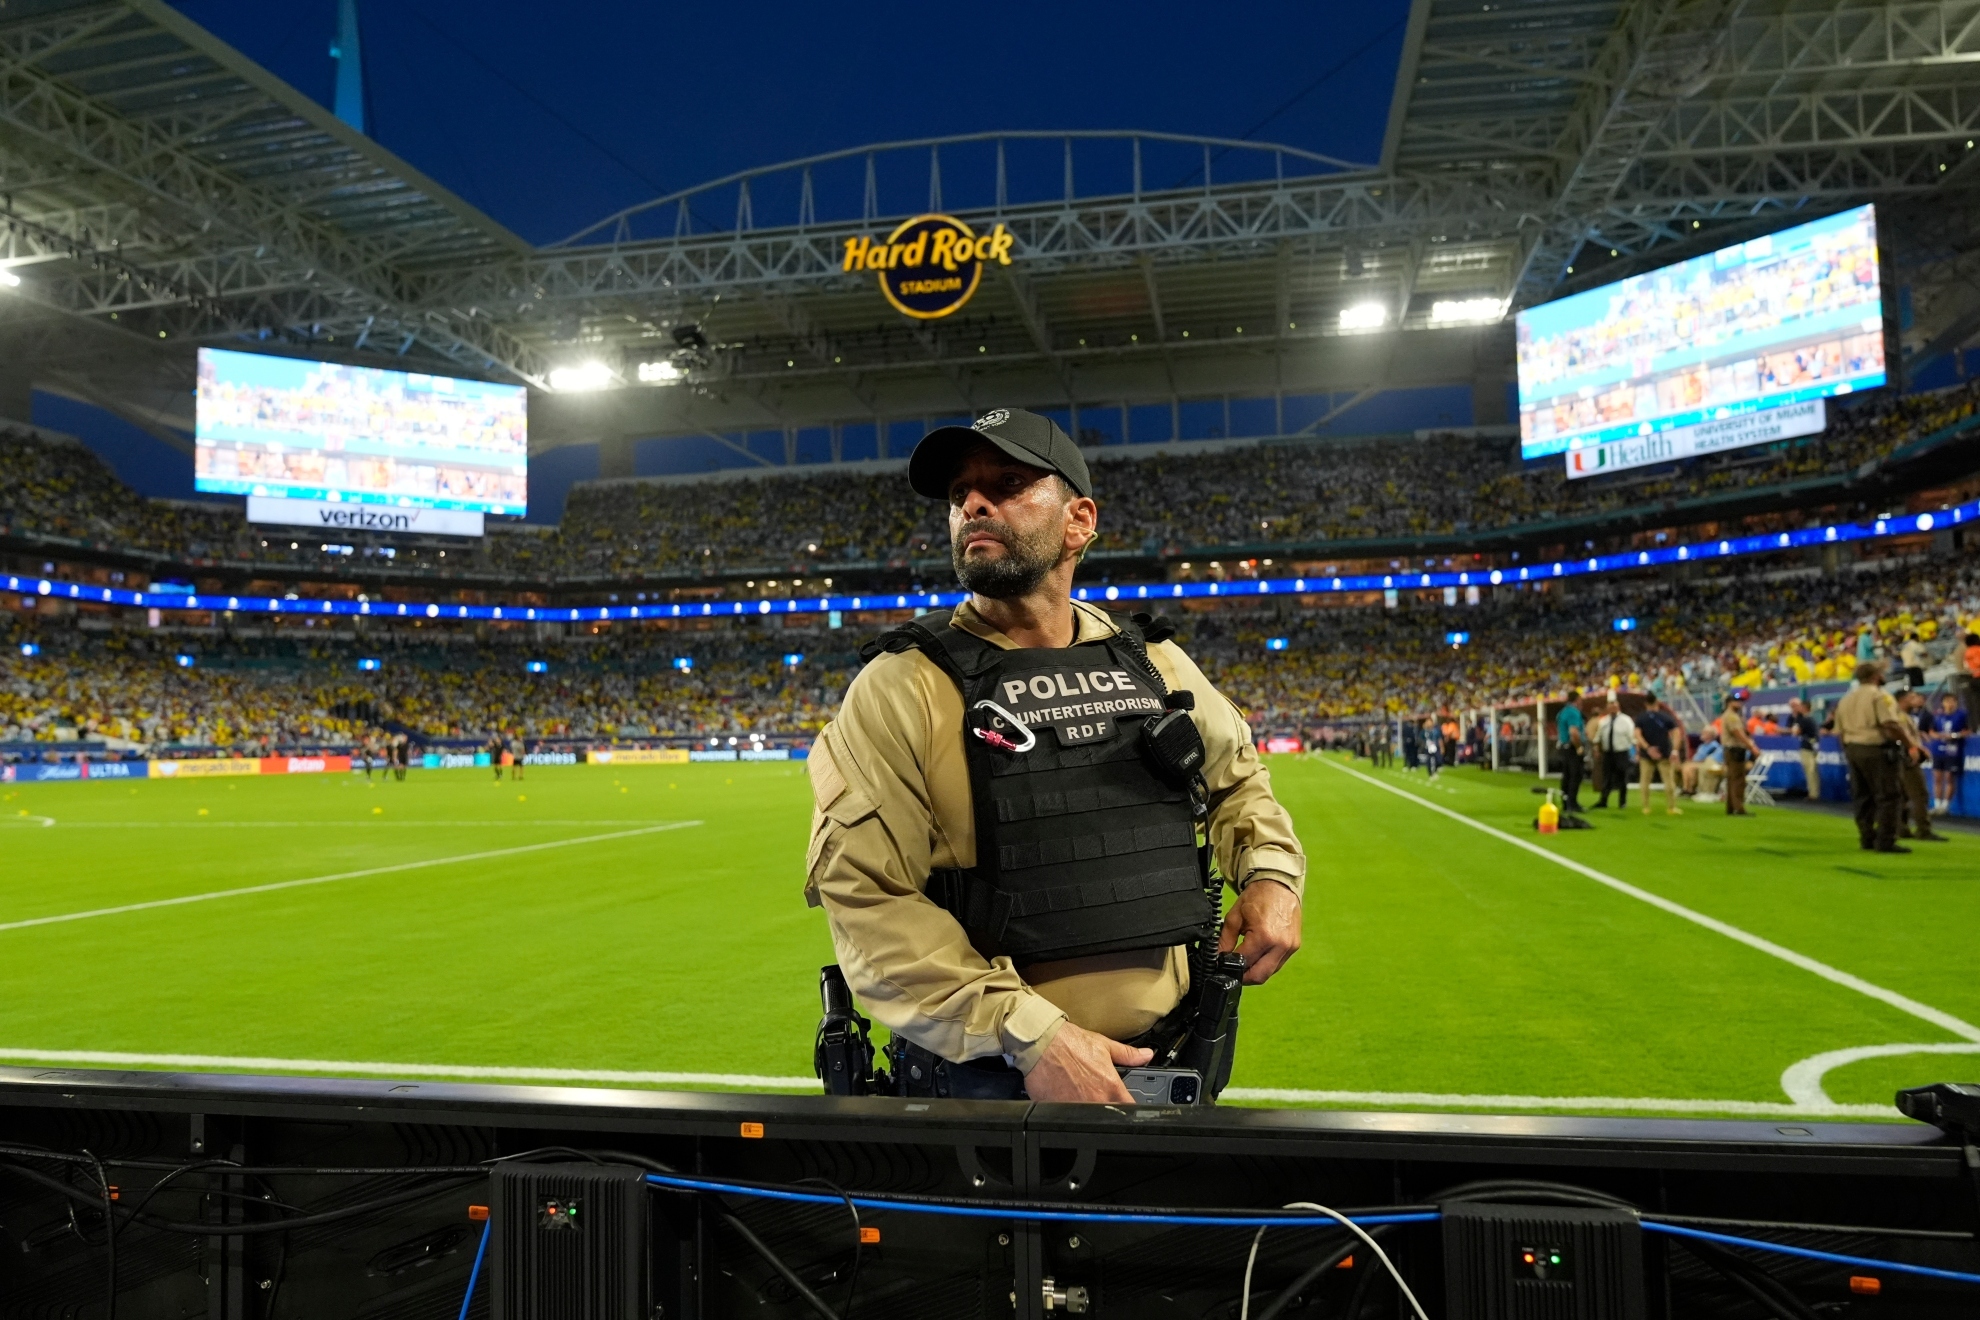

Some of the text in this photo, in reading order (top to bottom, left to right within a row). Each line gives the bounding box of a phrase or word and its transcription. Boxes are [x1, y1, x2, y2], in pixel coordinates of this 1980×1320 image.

[842, 222, 1014, 272] Hard Rock
[900, 277, 962, 295] STADIUM
[1693, 416, 1755, 437] UNIVERSITY
[1758, 413, 1772, 424] OF
[1776, 404, 1816, 420] MIAMI
[1694, 426, 1782, 449] HEALTH SYSTEM
[319, 507, 410, 529] verizon
[1002, 671, 1137, 704] POLICE
[992, 698, 1162, 729] CUNTERTERRORISM
[88, 763, 130, 777] ULTRA
[287, 757, 326, 773] Betano
